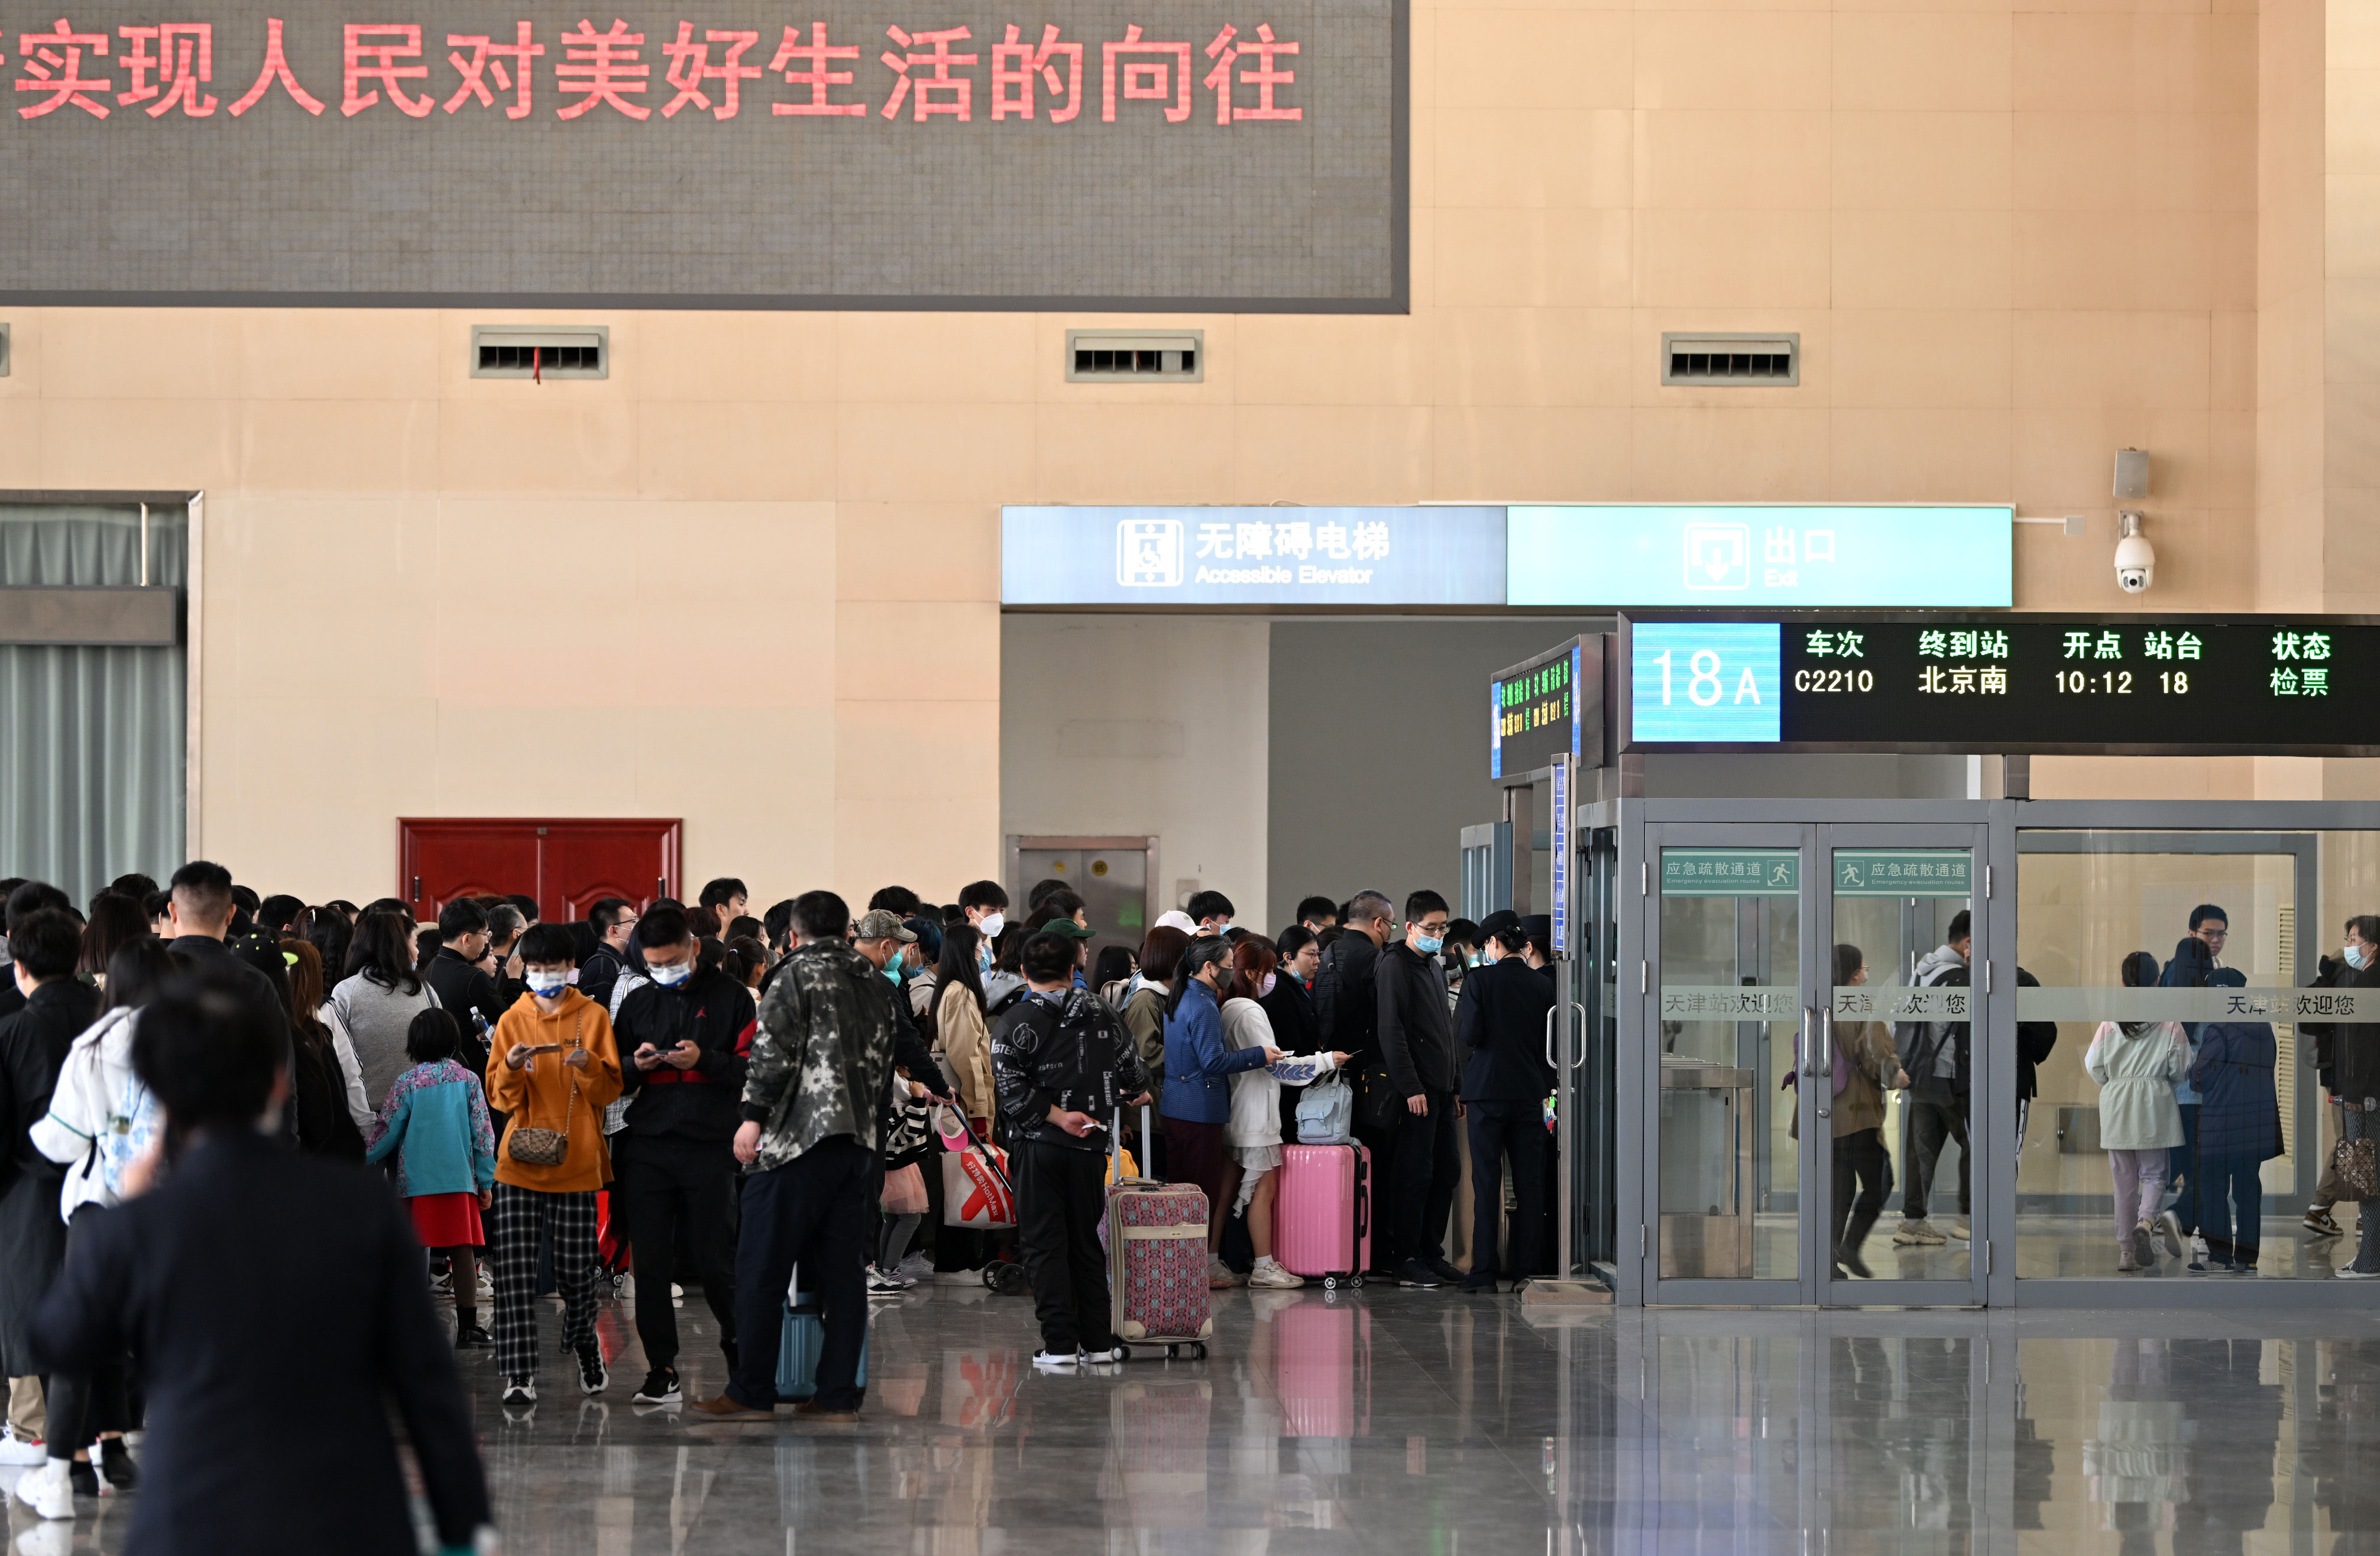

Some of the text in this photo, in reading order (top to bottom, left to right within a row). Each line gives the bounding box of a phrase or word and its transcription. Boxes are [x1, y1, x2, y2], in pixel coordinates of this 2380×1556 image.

[0, 18, 1302, 125] 实现人民对美好生活的向往
[1196, 521, 1390, 560] 无障碍电梯
[1764, 526, 1835, 565] 出口
[1195, 565, 1374, 584] Accessible Elevator
[1764, 569, 1798, 587] Exit
[1806, 630, 2331, 660] 车次 终到站 开点 站台 状态
[1795, 665, 2329, 696] C2210 北京南 10:12 18 检票
[1666, 862, 1761, 876] 应急疏散通道
[1871, 863, 1966, 877] 应急疏散通道
[1665, 993, 1793, 1013] 天津站欢迎您
[2227, 994, 2355, 1015] 天津站欢迎您
